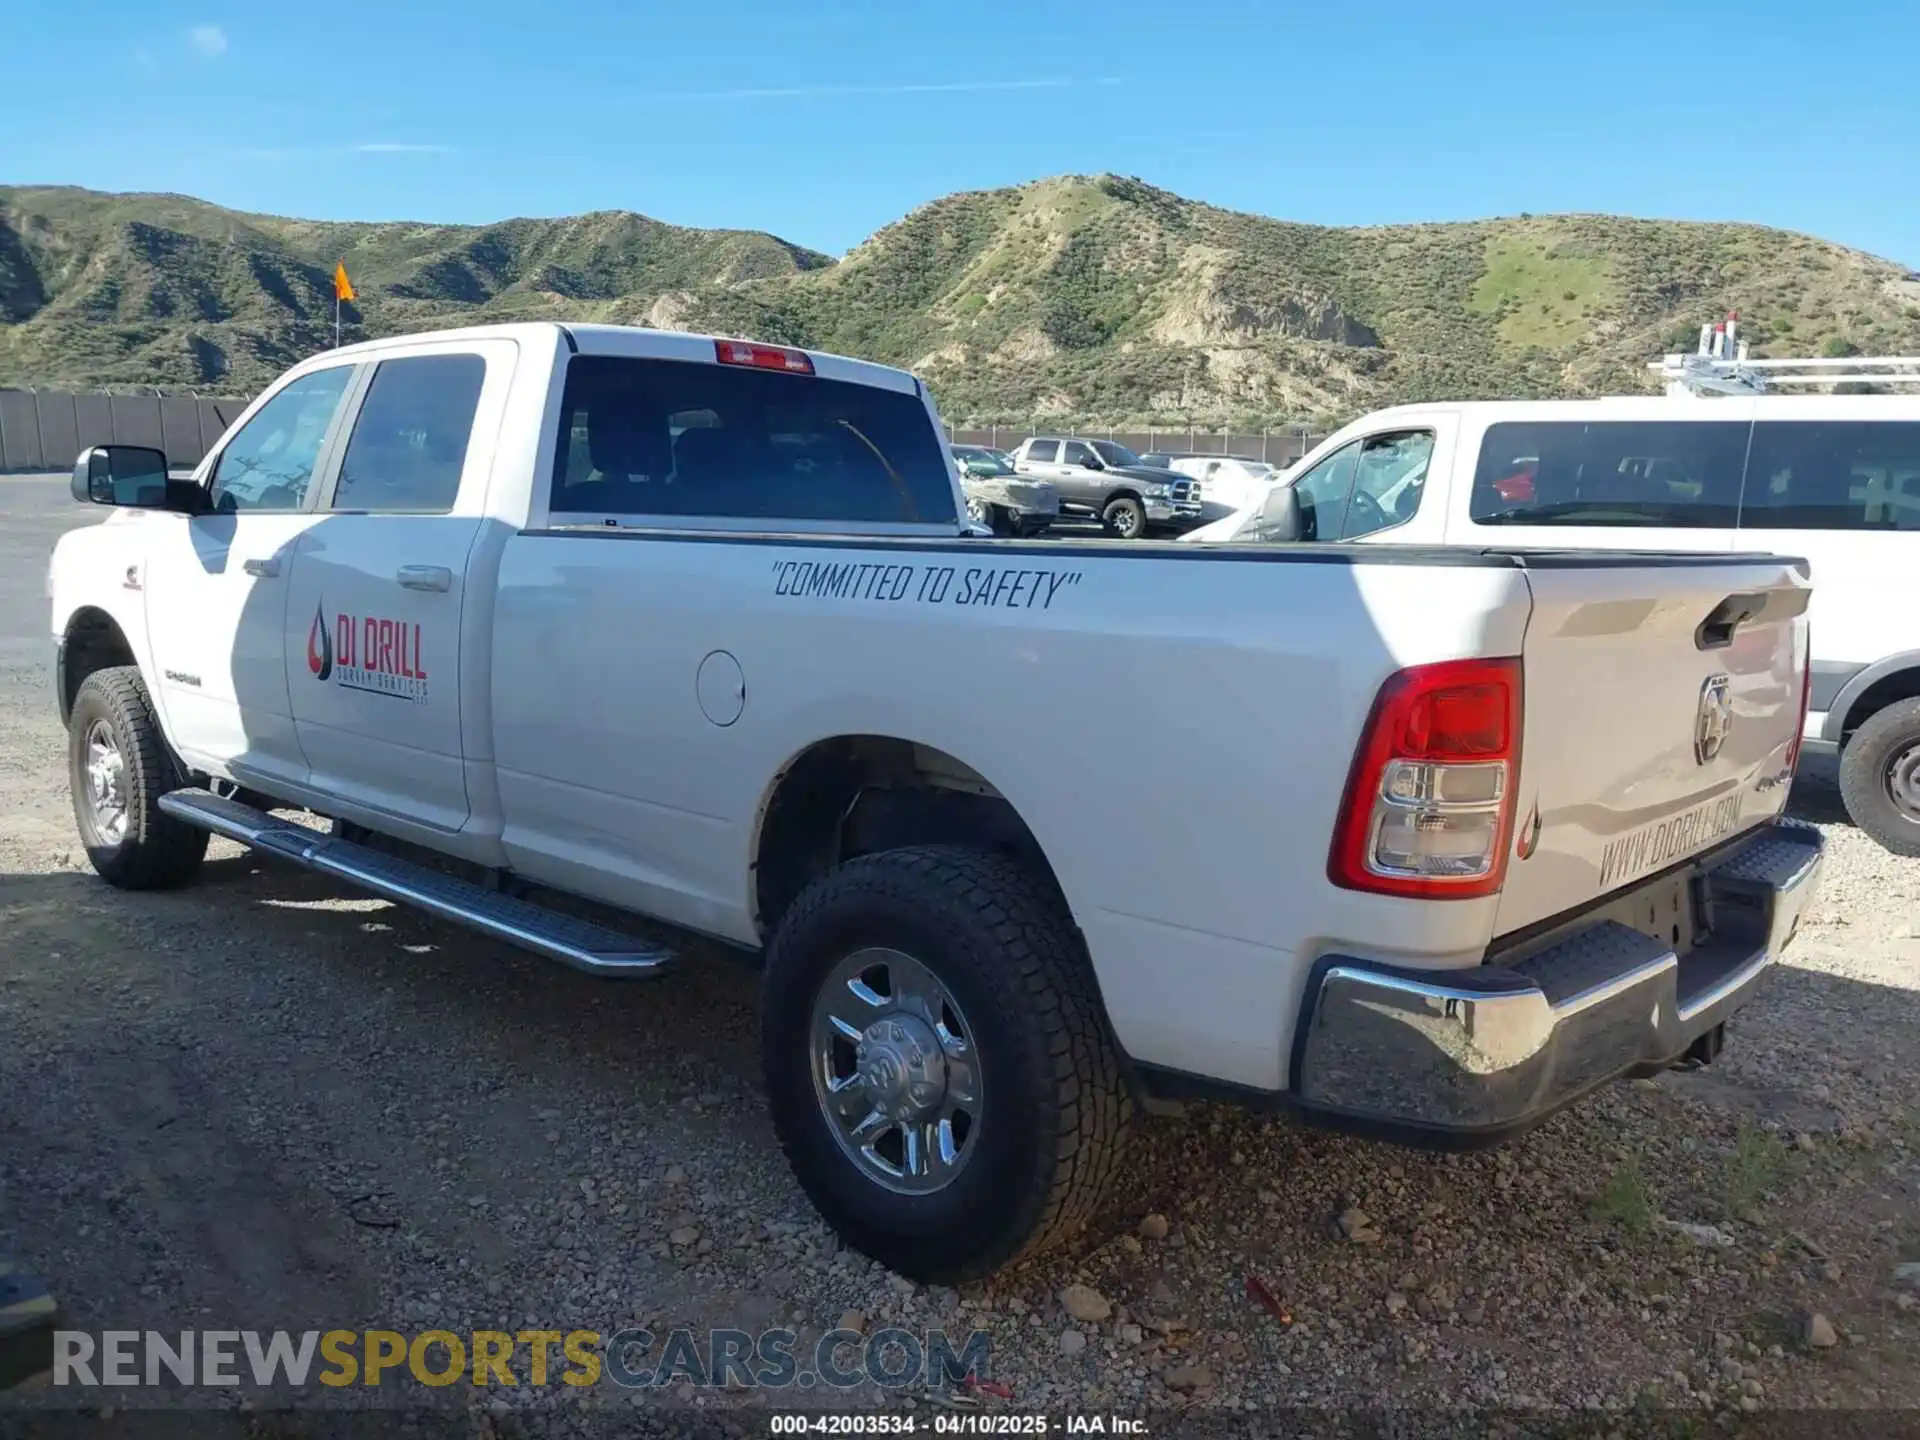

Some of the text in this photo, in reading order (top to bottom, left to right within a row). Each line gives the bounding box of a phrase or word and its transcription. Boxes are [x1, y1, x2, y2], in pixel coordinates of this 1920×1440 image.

[772, 560, 1084, 610] "COMMITTED TO SAFETY"
[337, 613, 428, 681] DI DRILL
[377, 673, 429, 697] SERVICES
[1599, 790, 1744, 887] WWW.DIDRILL.COM
